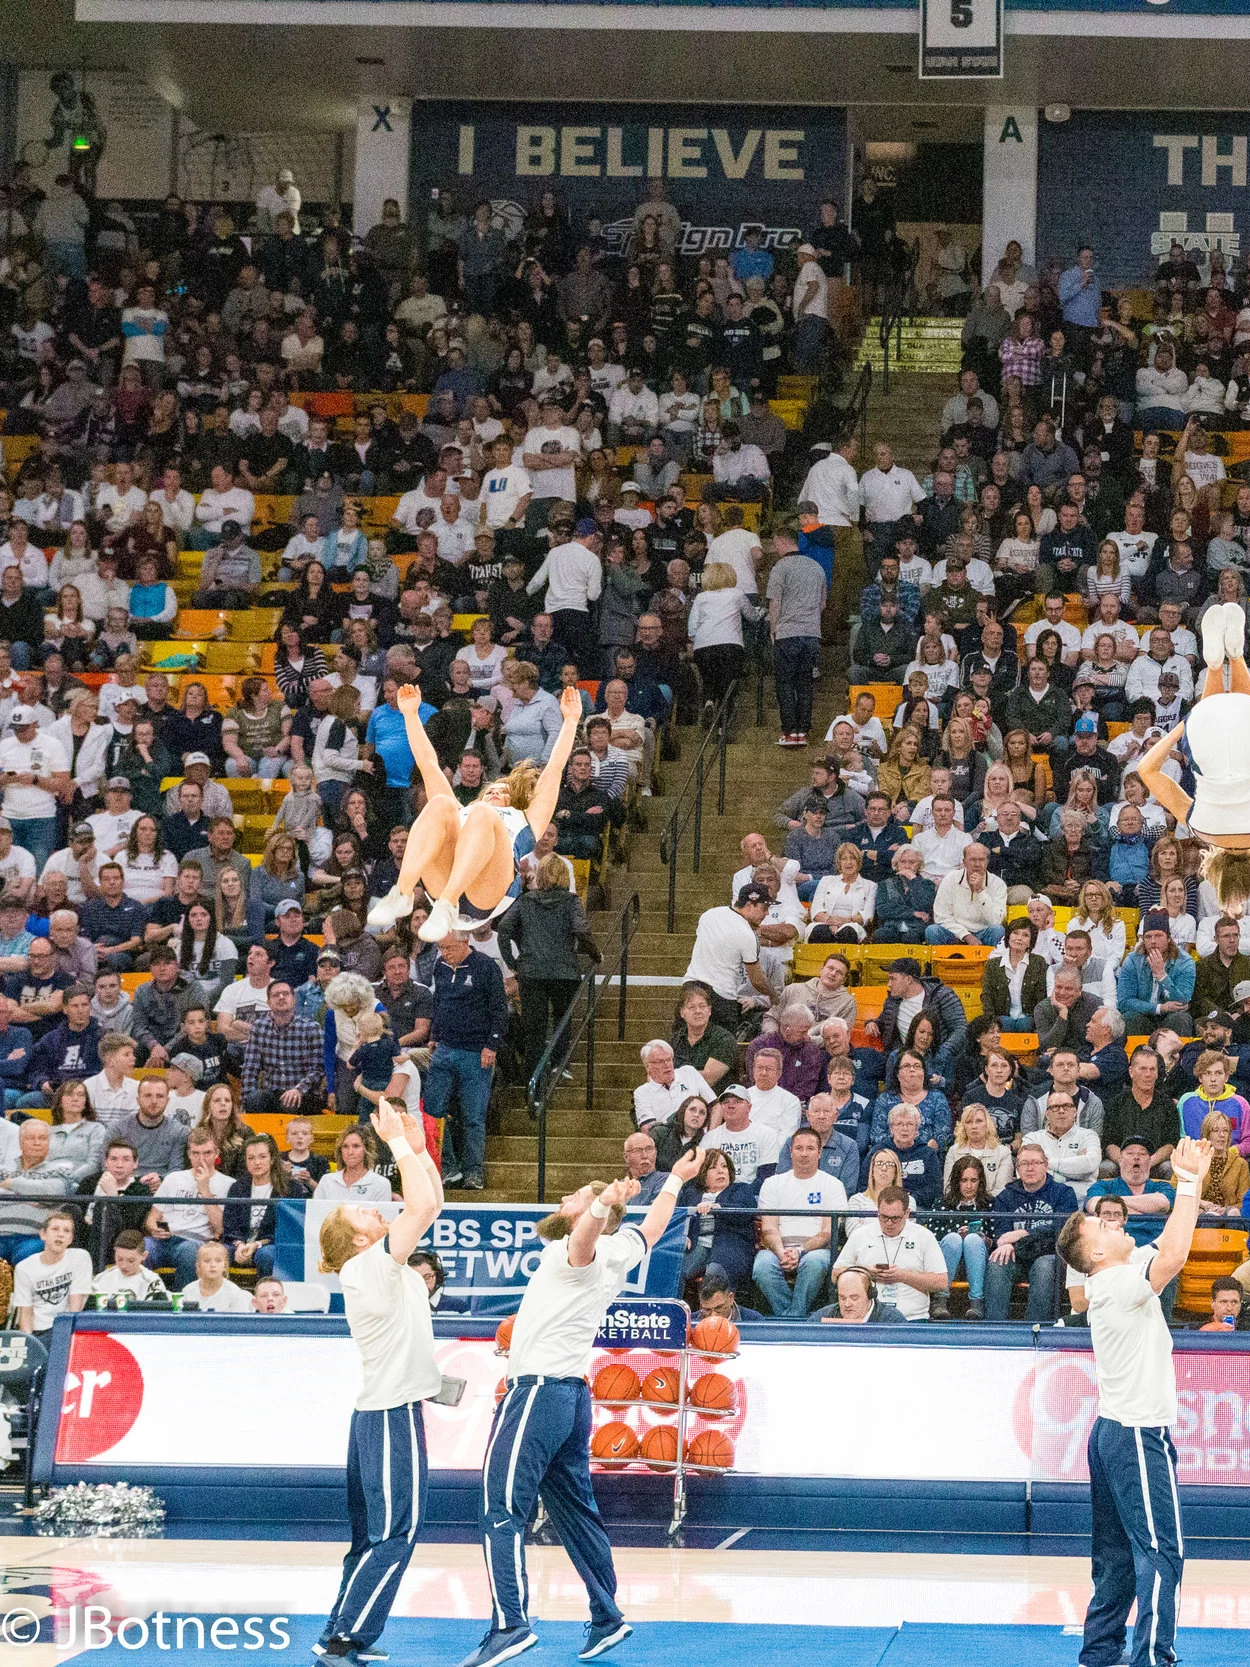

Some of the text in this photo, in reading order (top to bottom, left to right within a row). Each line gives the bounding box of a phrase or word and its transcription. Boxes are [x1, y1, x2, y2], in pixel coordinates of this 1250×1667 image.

[950, 0, 974, 28] 5
[372, 105, 393, 132] X
[999, 115, 1024, 143] A
[458, 125, 806, 181] I BELIEVE
[1151, 231, 1241, 256] STATE
[417, 1219, 485, 1248] BS
[36, 1279, 54, 1290] UTAH
[597, 1328, 671, 1341] KETBALL
